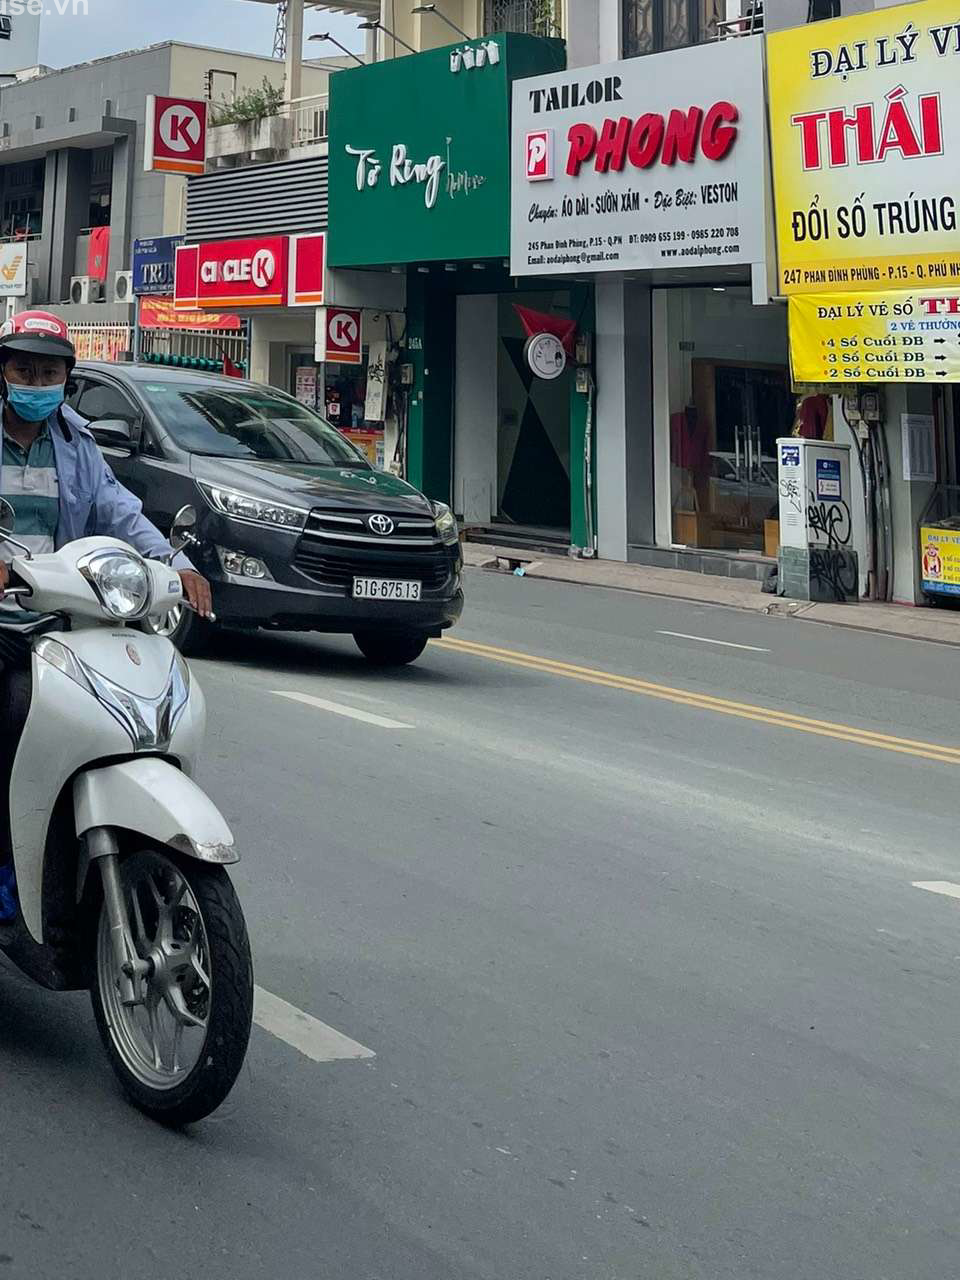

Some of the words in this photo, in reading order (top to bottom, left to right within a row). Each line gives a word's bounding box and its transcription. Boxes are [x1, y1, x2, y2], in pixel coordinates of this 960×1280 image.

[811, 42, 867, 81] ĐẠI
[876, 24, 919, 66] LÝ
[529, 76, 623, 114] TAILOR
[566, 101, 739, 177] PHONG
[792, 84, 944, 172] THÁI
[561, 194, 573, 217] ÁO
[576, 193, 589, 216] DÀI
[621, 188, 640, 212] XÁM
[654, 190, 672, 212] Đặc
[701, 182, 738, 205] VESTON
[792, 194, 829, 241] ĐỔI
[837, 192, 867, 238] SỐ
[873, 192, 957, 235] TRÚNG
[589, 237, 603, 247] P.15
[658, 231, 671, 242] 655
[673, 230, 685, 241] 199
[710, 227, 725, 238] 220
[726, 226, 740, 237] 708
[528, 255, 546, 265] Email:
[547, 251, 620, 264] aodaiphong@gmail.com
[661, 244, 740, 257] www.aodaiphong.com
[784, 269, 801, 284] 247
[804, 270, 826, 283] PHAN
[828, 266, 848, 282] ĐÌNH
[851, 264, 880, 281] PHÙNG
[888, 265, 908, 279] P.15
[916, 264, 926, 279] Q.
[928, 260, 947, 277] PHÚ
[818, 306, 842, 320] ĐẠI
[847, 302, 864, 317] LÝ
[869, 301, 889, 316] VÉ
[893, 296, 914, 316] SỐ
[890, 322, 897, 331] 2
[901, 319, 915, 331] VÉ
[827, 338, 835, 347] 4
[840, 335, 858, 347] Số
[863, 334, 897, 347] Cuối
[902, 336, 924, 346] ĐB
[828, 353, 837, 362] 3
[842, 350, 859, 362] Số
[864, 350, 898, 362] Cuối
[903, 352, 925, 362] ĐB
[829, 369, 838, 378] 2
[843, 366, 861, 378] Số
[866, 366, 899, 378] Cuối
[904, 368, 925, 378] ĐB
